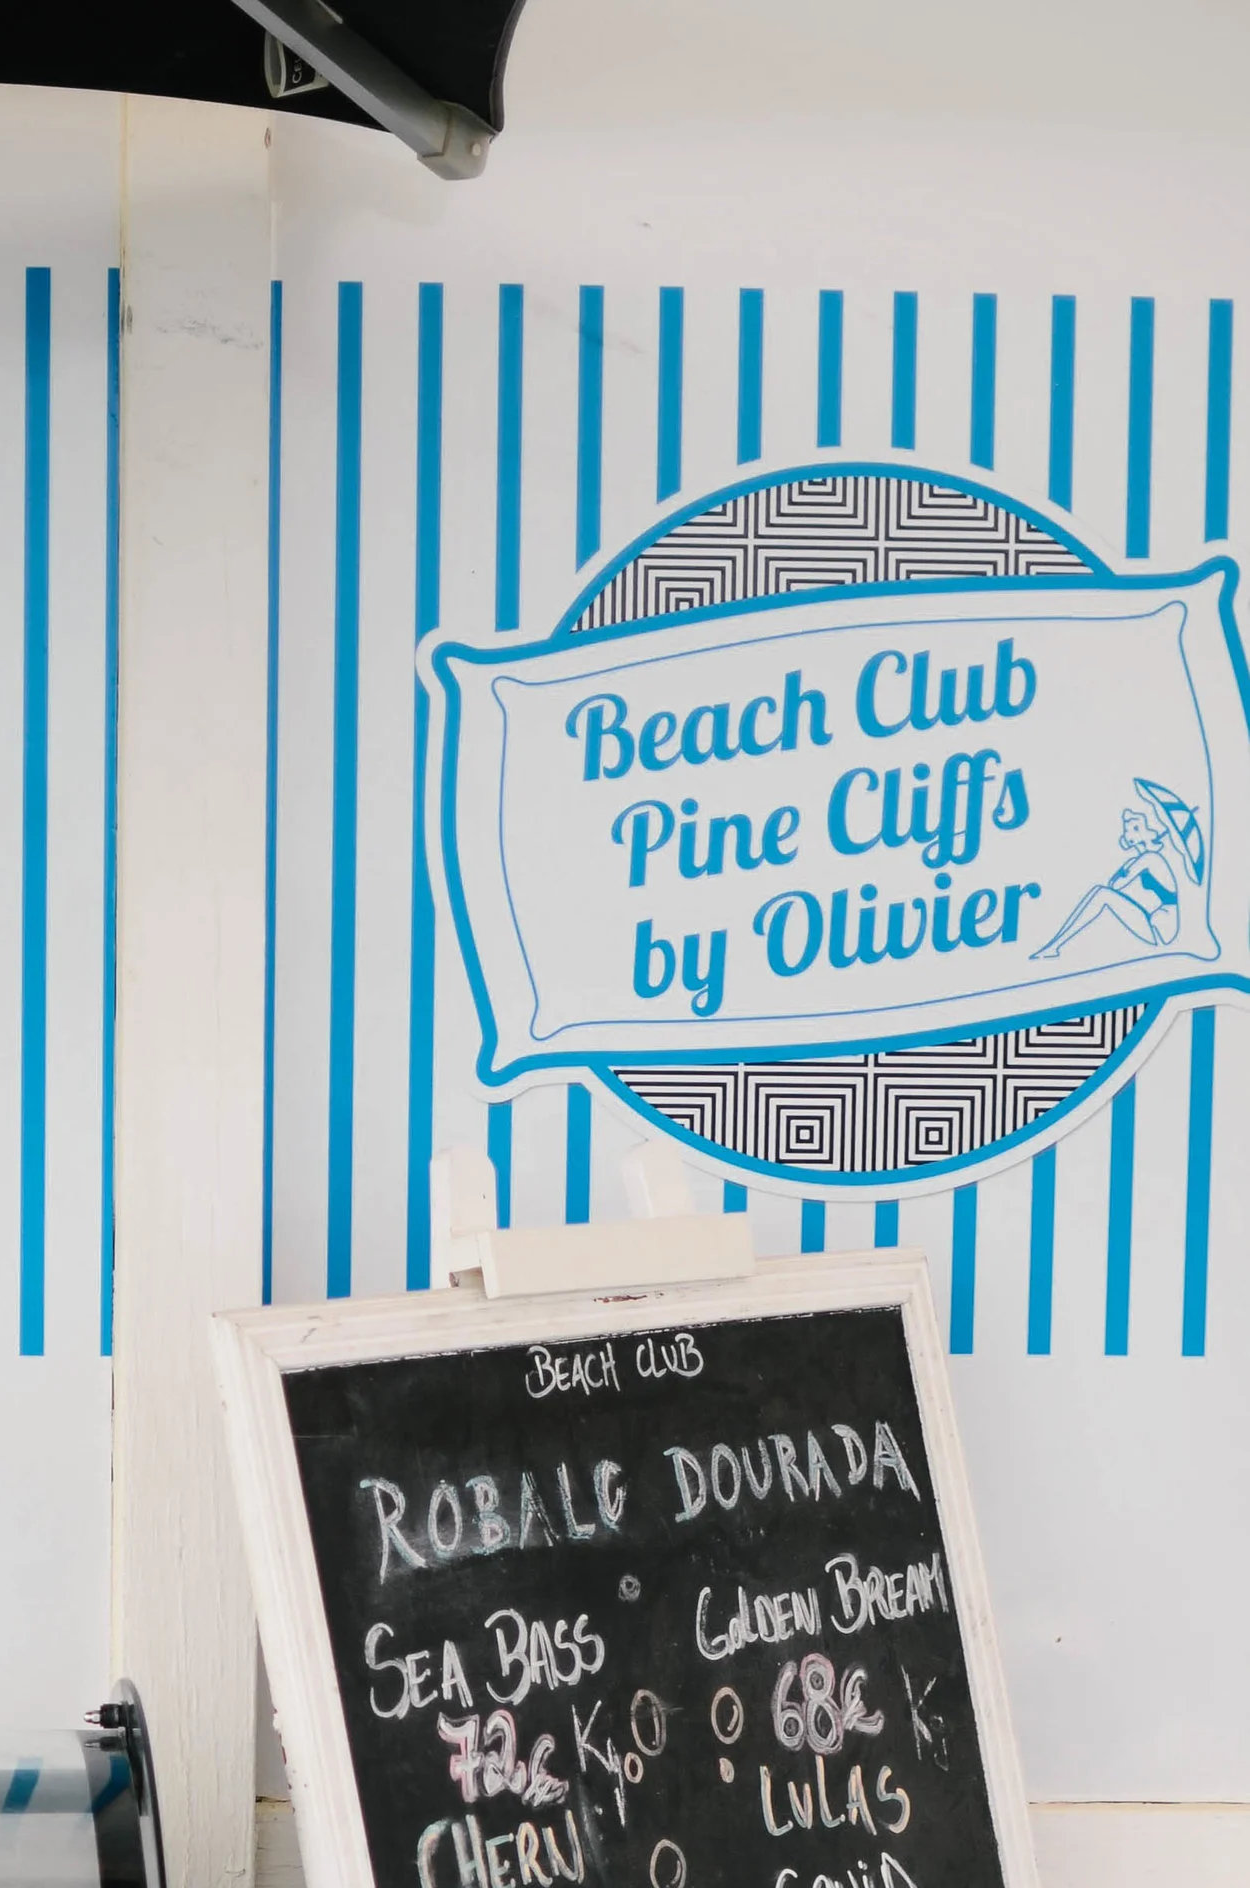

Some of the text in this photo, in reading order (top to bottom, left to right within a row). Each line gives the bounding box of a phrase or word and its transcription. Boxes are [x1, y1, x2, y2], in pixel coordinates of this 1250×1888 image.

[566, 639, 1036, 781] Beach Club
[612, 749, 1029, 887] Pine Cliffs
[633, 873, 1041, 1018] by Olivier
[525, 1345, 621, 1399] BEACH
[663, 1420, 921, 1522] DOURADA
[825, 1552, 949, 1634] BREAM
[364, 1608, 605, 1719] SEA BASS
[760, 1754, 910, 1836] LULAS
